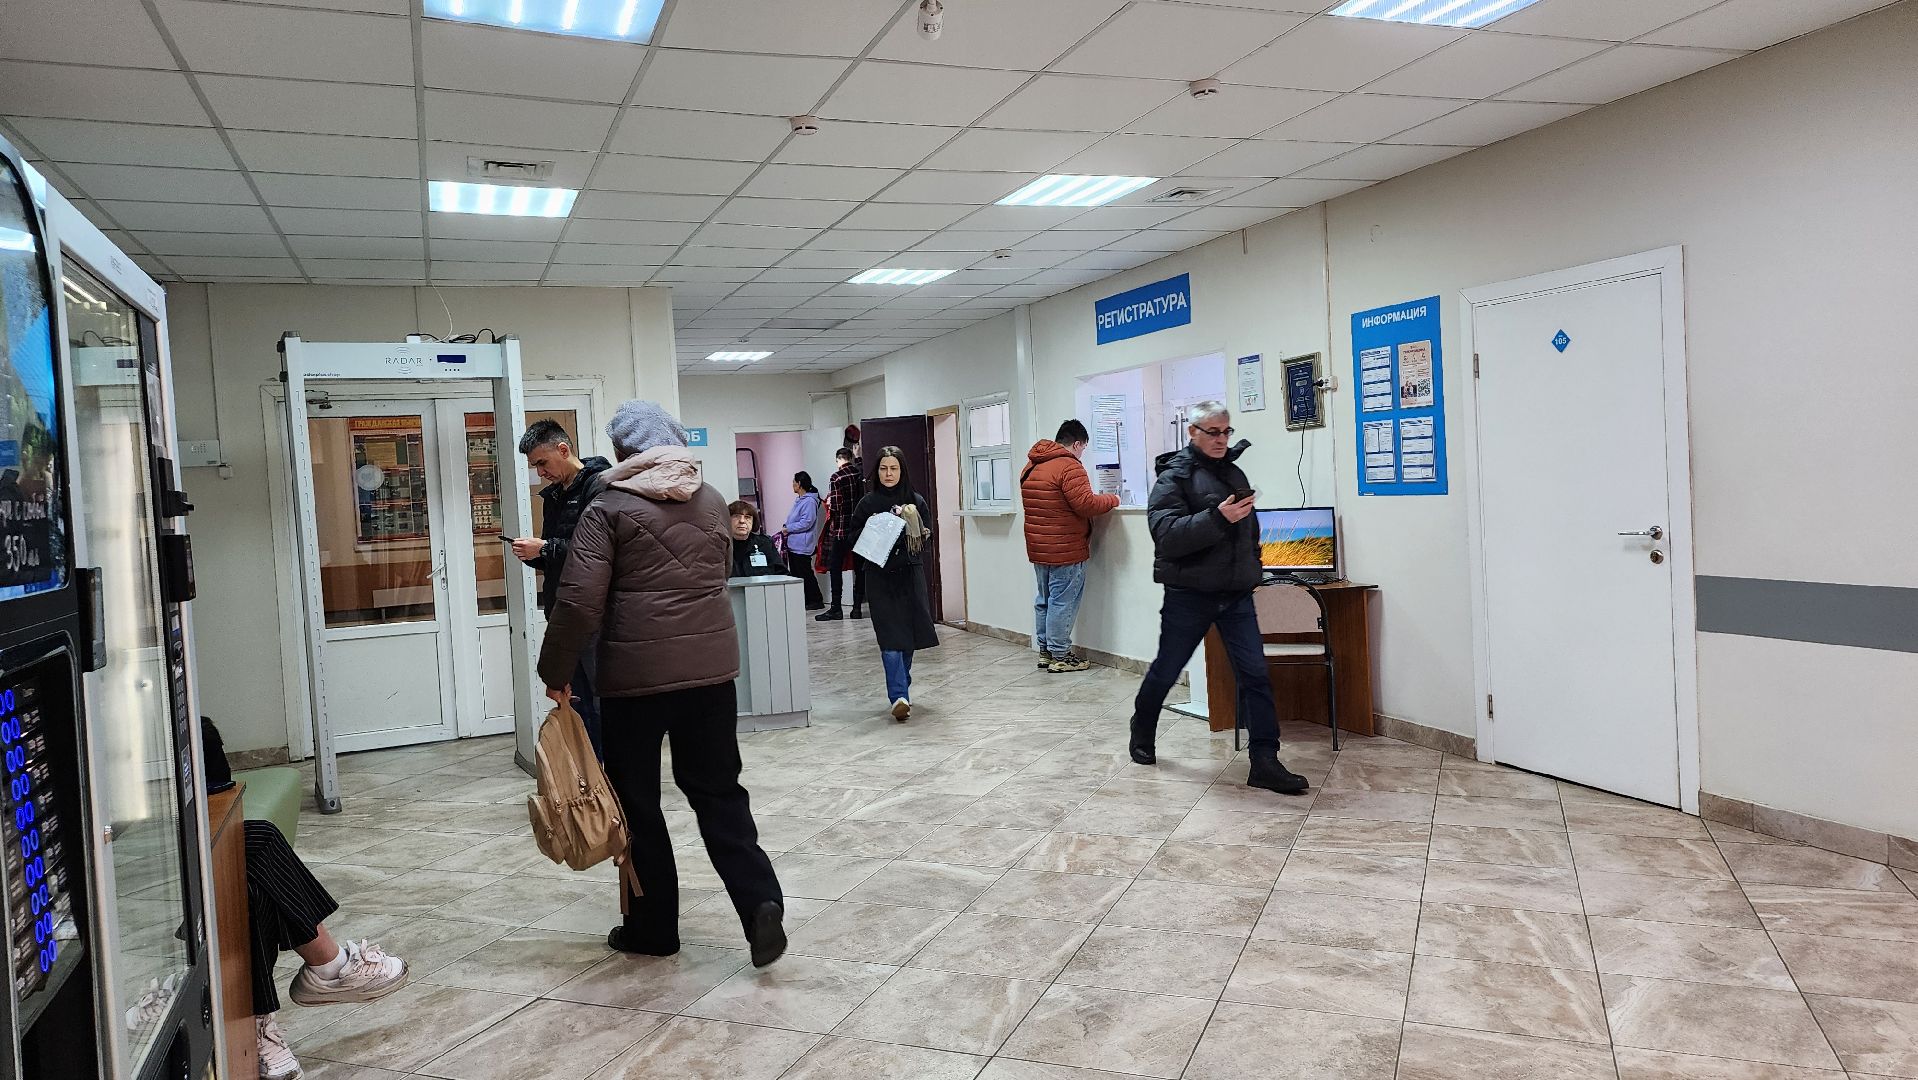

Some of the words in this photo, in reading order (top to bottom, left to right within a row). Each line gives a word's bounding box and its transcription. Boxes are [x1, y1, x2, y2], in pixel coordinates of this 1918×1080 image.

[1097, 291, 1187, 330] РЕГИСТРАТУРА
[1361, 305, 1427, 329] ИНФОРМАЦИЯ
[1554, 337, 1567, 345] 105
[385, 357, 423, 365] RADAR
